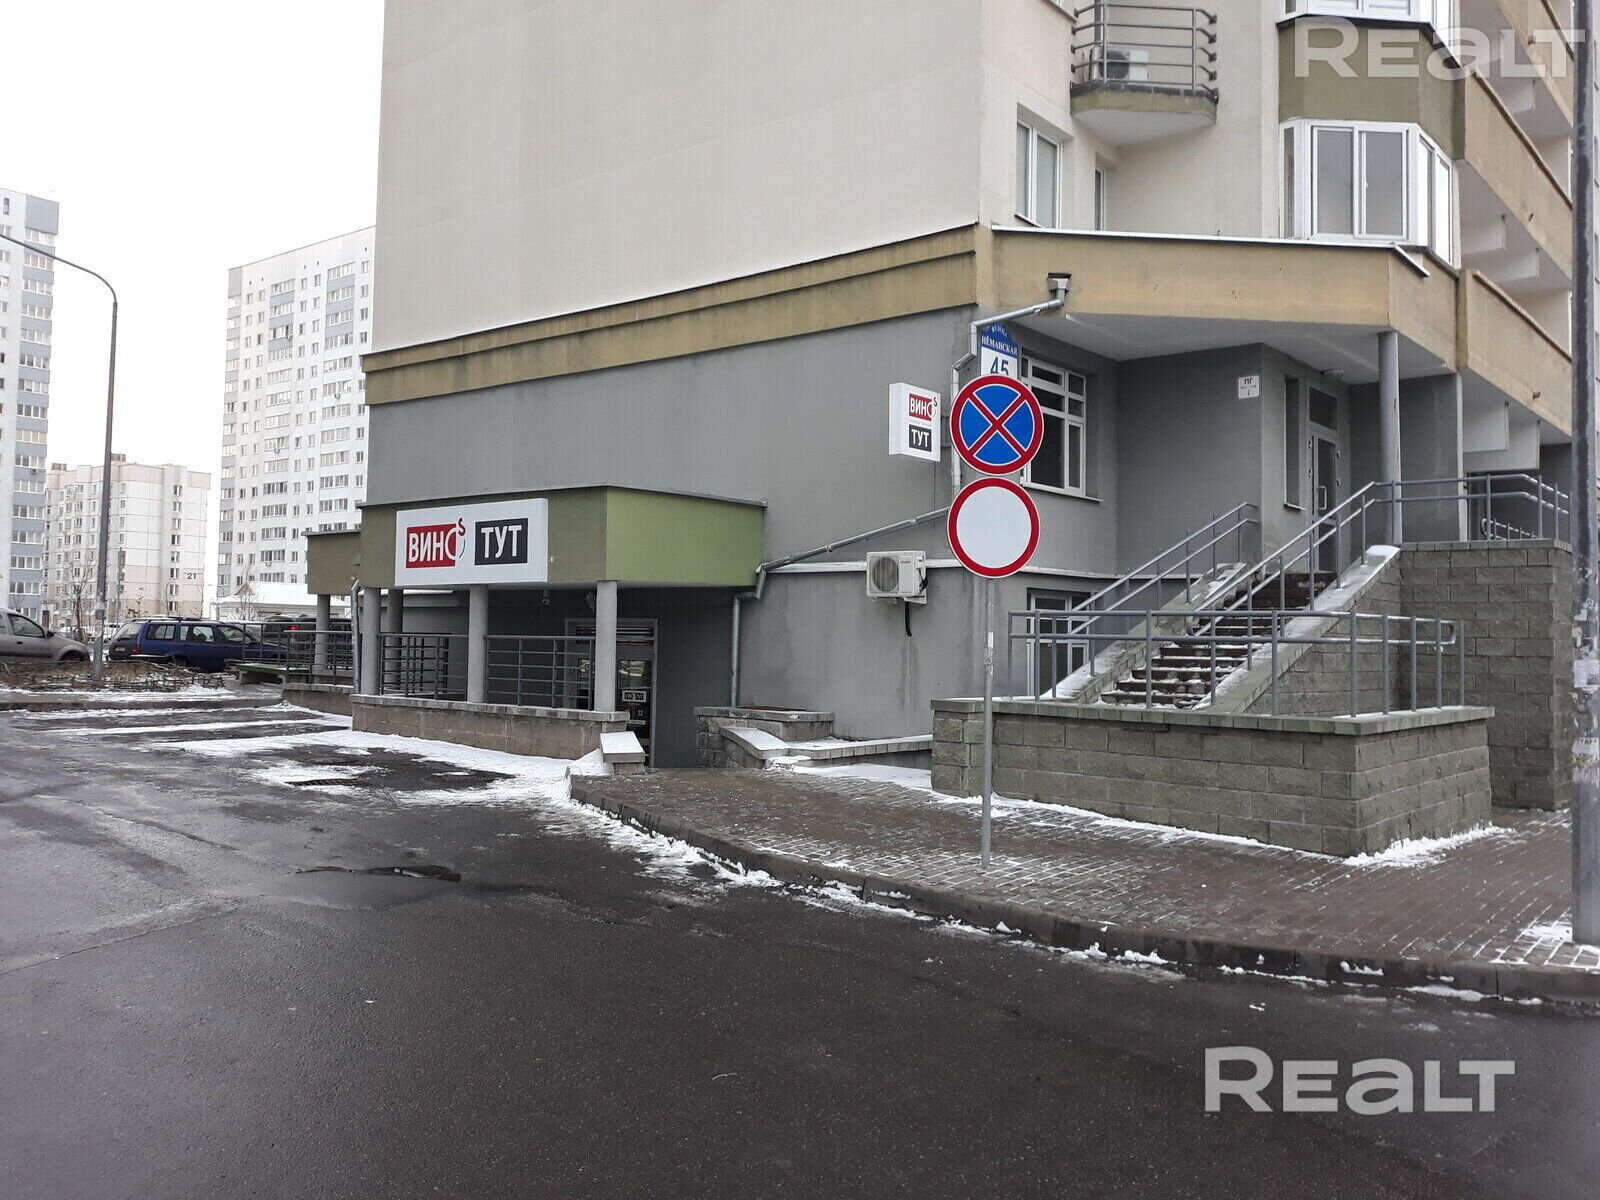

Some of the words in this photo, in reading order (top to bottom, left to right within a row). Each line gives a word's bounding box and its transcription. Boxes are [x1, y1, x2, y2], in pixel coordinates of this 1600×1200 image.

[981, 335, 1018, 356] НЁМАНСКАЯ
[990, 356, 1009, 376] 45
[911, 428, 930, 448] ТУТ
[481, 524, 522, 559] ТУТ
